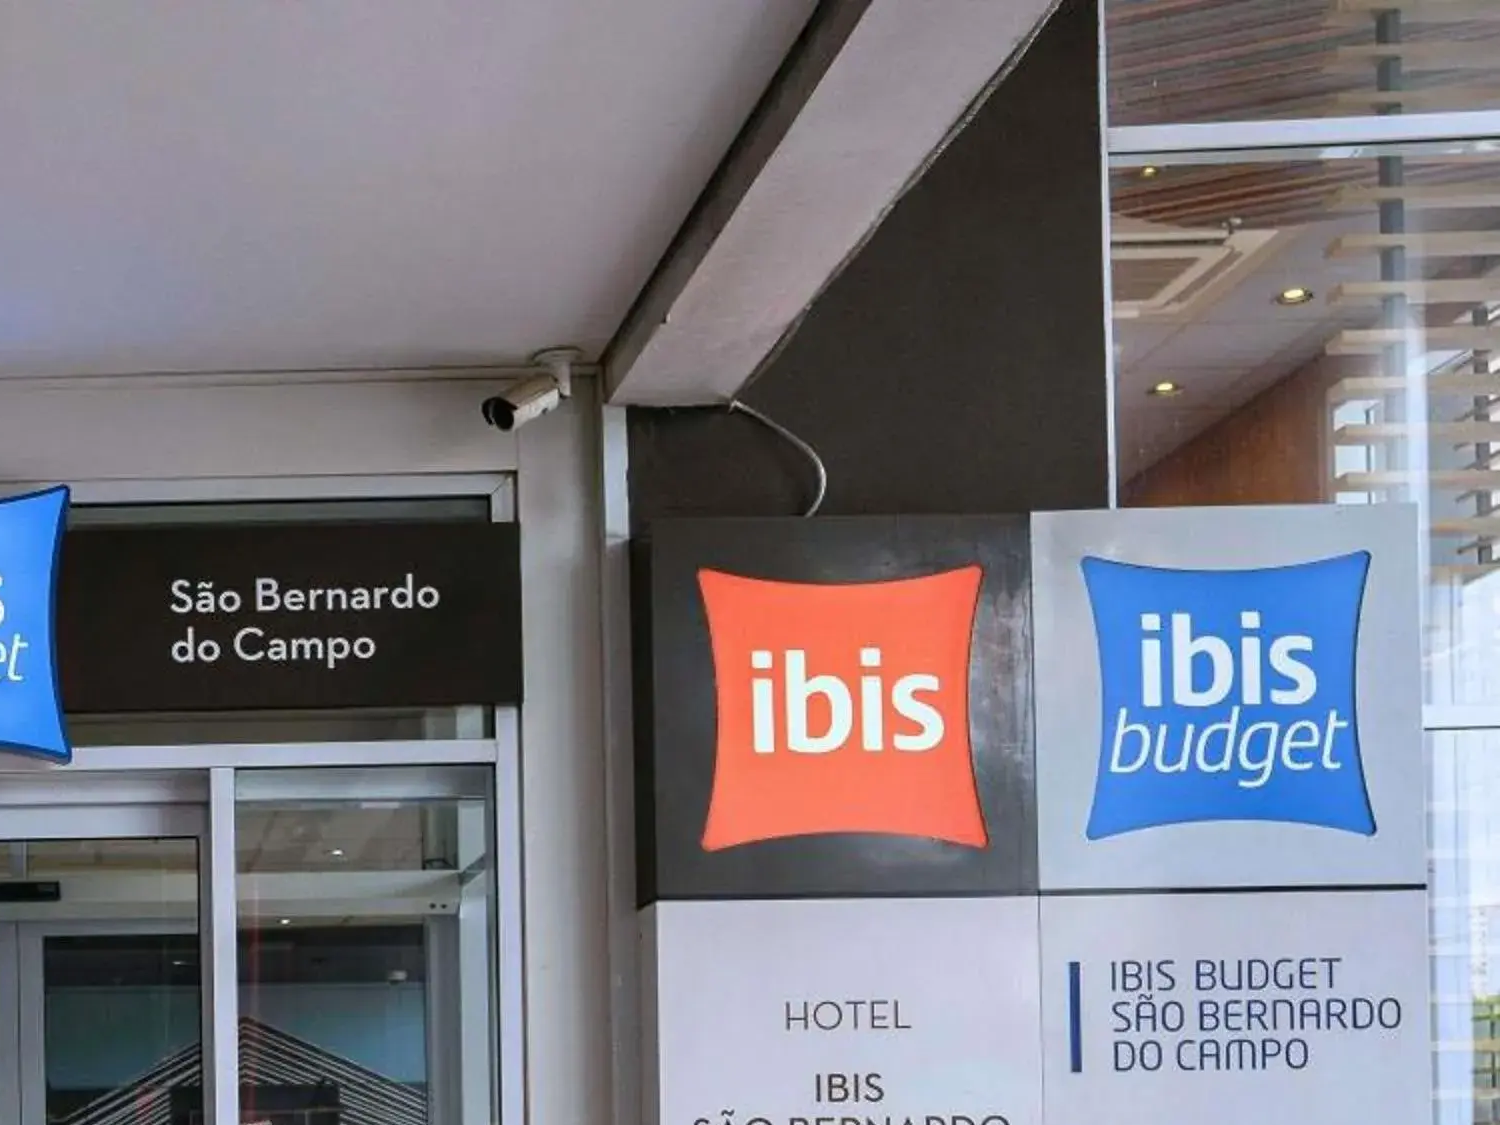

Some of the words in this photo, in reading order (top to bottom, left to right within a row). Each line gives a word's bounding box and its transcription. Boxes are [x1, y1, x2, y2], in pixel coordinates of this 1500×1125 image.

[171, 580, 241, 614] São
[256, 574, 440, 612] Bernardo
[172, 627, 221, 663] do
[234, 627, 376, 669] Campo
[1142, 612, 1317, 707] ibis
[752, 648, 945, 753] ibis
[1110, 704, 1348, 788] budget
[1111, 960, 1176, 992] IBIS
[1196, 958, 1342, 990] BUDGET
[785, 1000, 912, 1031] HOTEL
[1112, 992, 1184, 1031] SÃO
[1199, 998, 1402, 1031] BERNARDO
[1114, 1040, 1163, 1072] DO
[1177, 1038, 1309, 1070] CAMPO
[815, 1073, 885, 1103] IBIS
